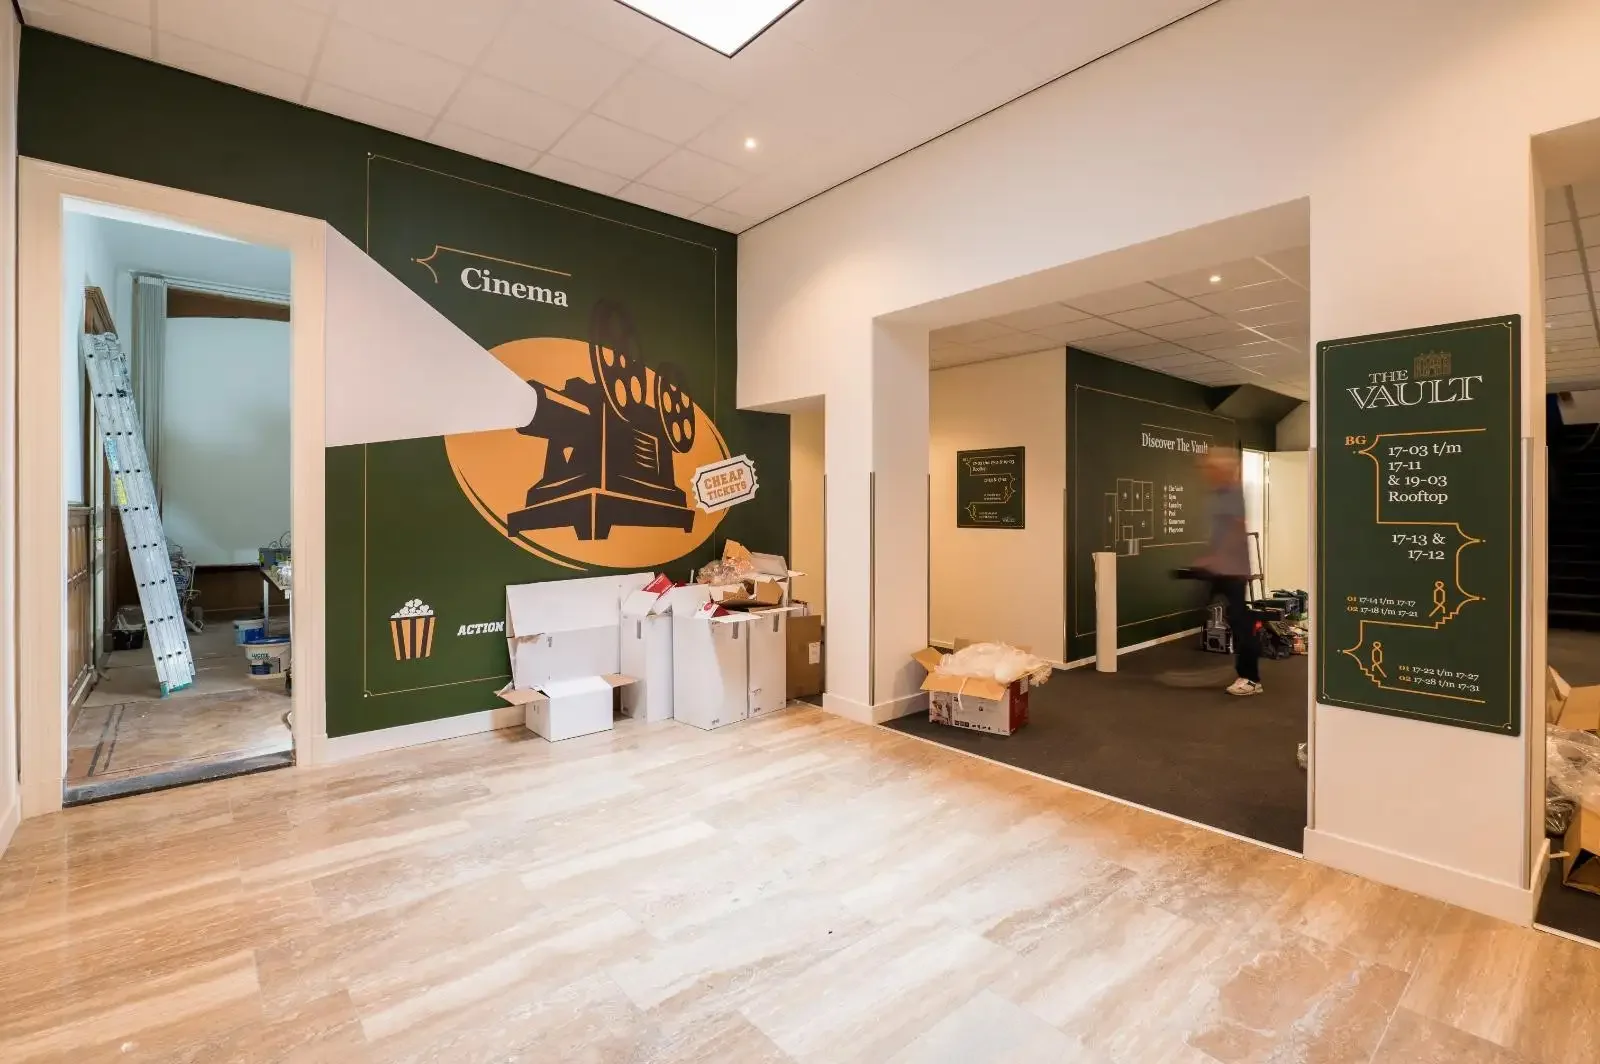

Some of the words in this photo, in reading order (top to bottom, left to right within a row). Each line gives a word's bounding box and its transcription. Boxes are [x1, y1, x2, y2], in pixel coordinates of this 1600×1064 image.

[460, 267, 569, 308] Cinema
[1368, 369, 1409, 384] THE
[1346, 375, 1483, 409] VAULT
[1142, 432, 1175, 450] Discover
[1176, 437, 1190, 452] The
[1191, 440, 1208, 455] Vault
[1345, 435, 1367, 446] BG
[1388, 445, 1428, 457] 17-03
[1433, 442, 1462, 454] t/m
[1388, 461, 1422, 471] 17-11
[704, 468, 744, 490] CHEAP
[1388, 474, 1400, 486] &
[1405, 475, 1448, 487] 19-03
[707, 481, 747, 501] TICKETS
[1389, 490, 1448, 504] Rooftop
[1392, 533, 1428, 546] 17-13
[1432, 533, 1446, 545] &
[1408, 550, 1445, 561] 17-12
[1360, 597, 1378, 605] 17-14
[1380, 597, 1395, 605] t/m
[1381, 607, 1396, 616] t/m
[1398, 610, 1419, 618] 17-21
[457, 621, 505, 636] ACTION
[1412, 666, 1435, 675] 17-22
[1455, 672, 1480, 681] 17-27
[1413, 677, 1437, 685] 17-28
[1458, 683, 1480, 692] 17-31
